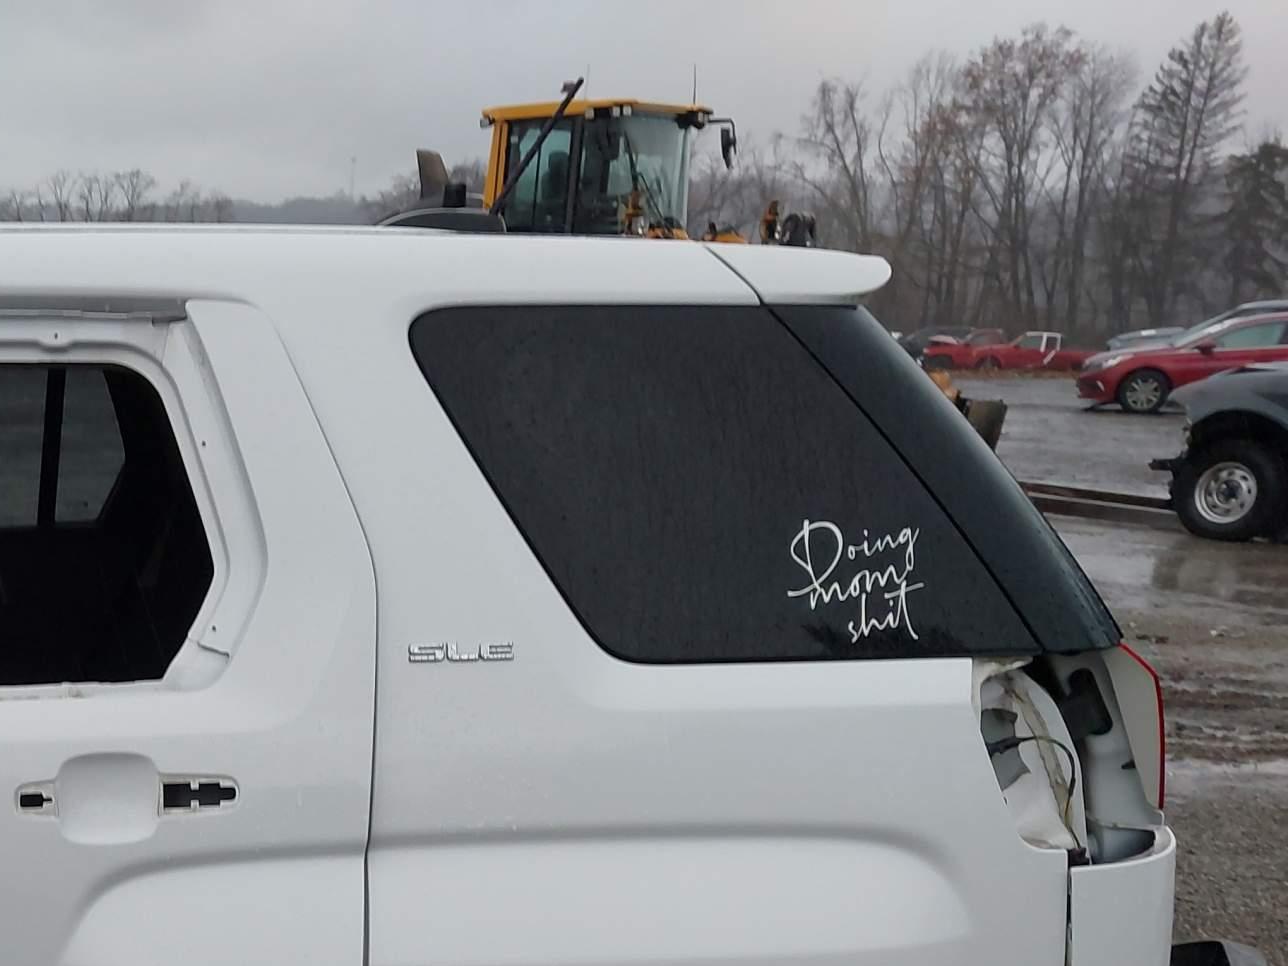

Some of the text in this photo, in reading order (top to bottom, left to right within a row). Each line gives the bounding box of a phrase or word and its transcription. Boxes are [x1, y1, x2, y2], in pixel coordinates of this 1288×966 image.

[787, 518, 920, 597] Doing
[847, 579, 925, 644] shit
[407, 640, 515, 663] SLE
